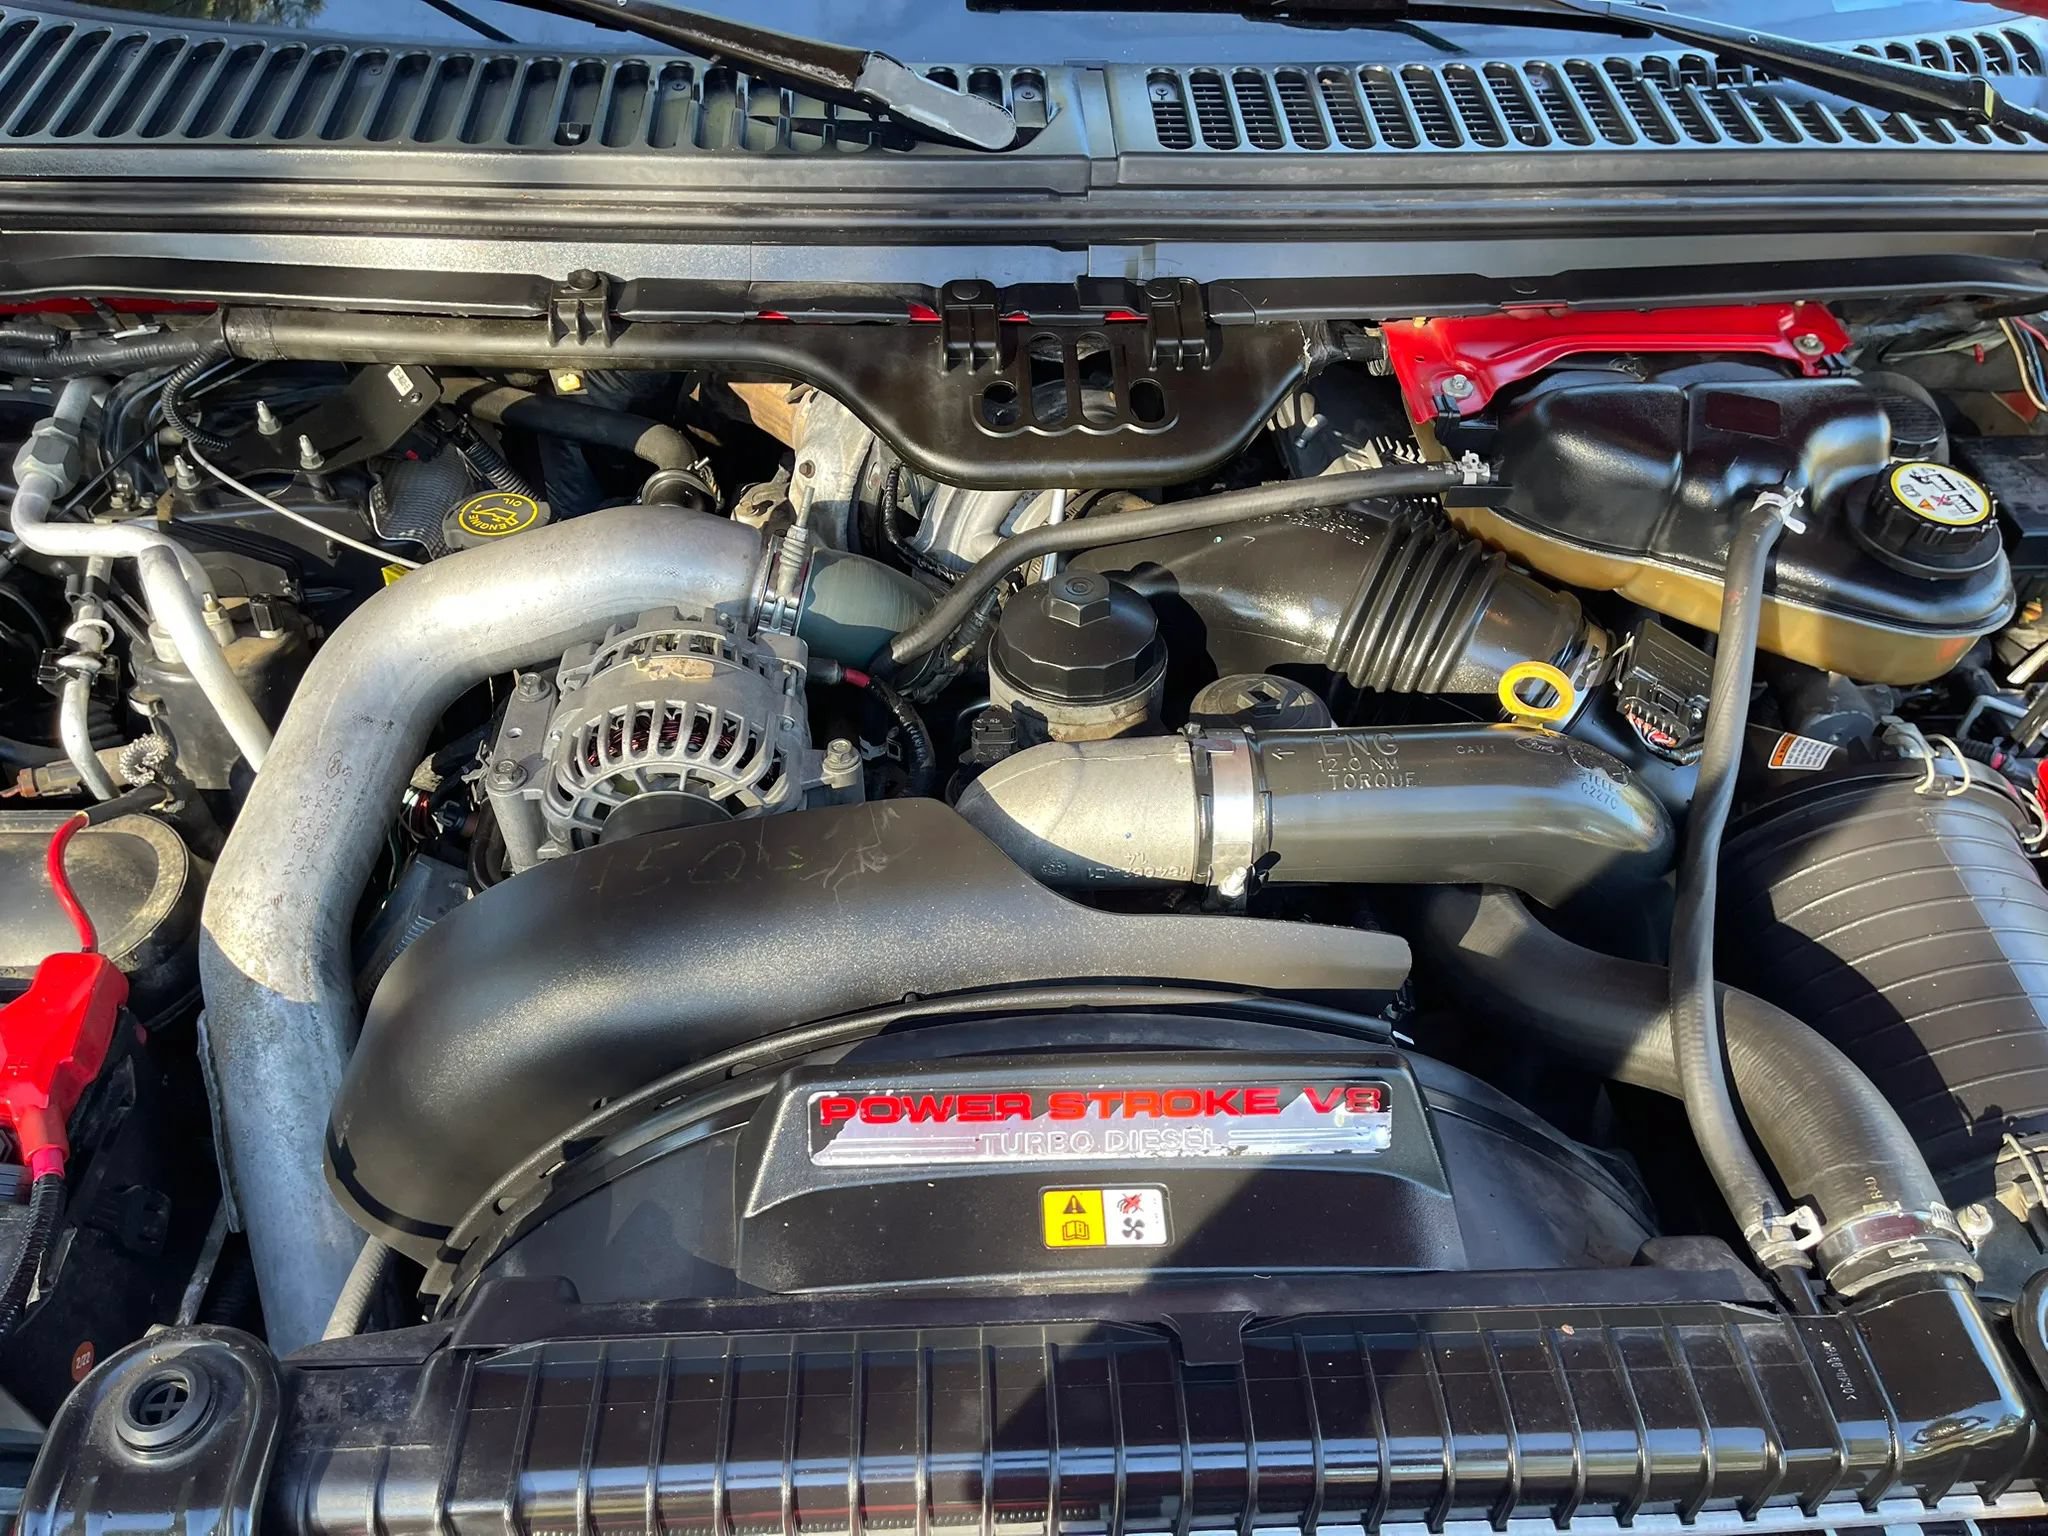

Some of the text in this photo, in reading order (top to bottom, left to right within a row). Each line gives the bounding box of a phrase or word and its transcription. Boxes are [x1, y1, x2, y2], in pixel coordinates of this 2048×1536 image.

[503, 498, 522, 507] OIL
[468, 513, 507, 530] ENGINE
[1319, 733, 1399, 757] ENG
[1317, 757, 1400, 772] 12.0 NM
[1328, 772, 1416, 790] TORQUE
[819, 1087, 1382, 1127] POWER STROKE V8
[978, 1127, 1222, 1155] TURBO DIESEL
